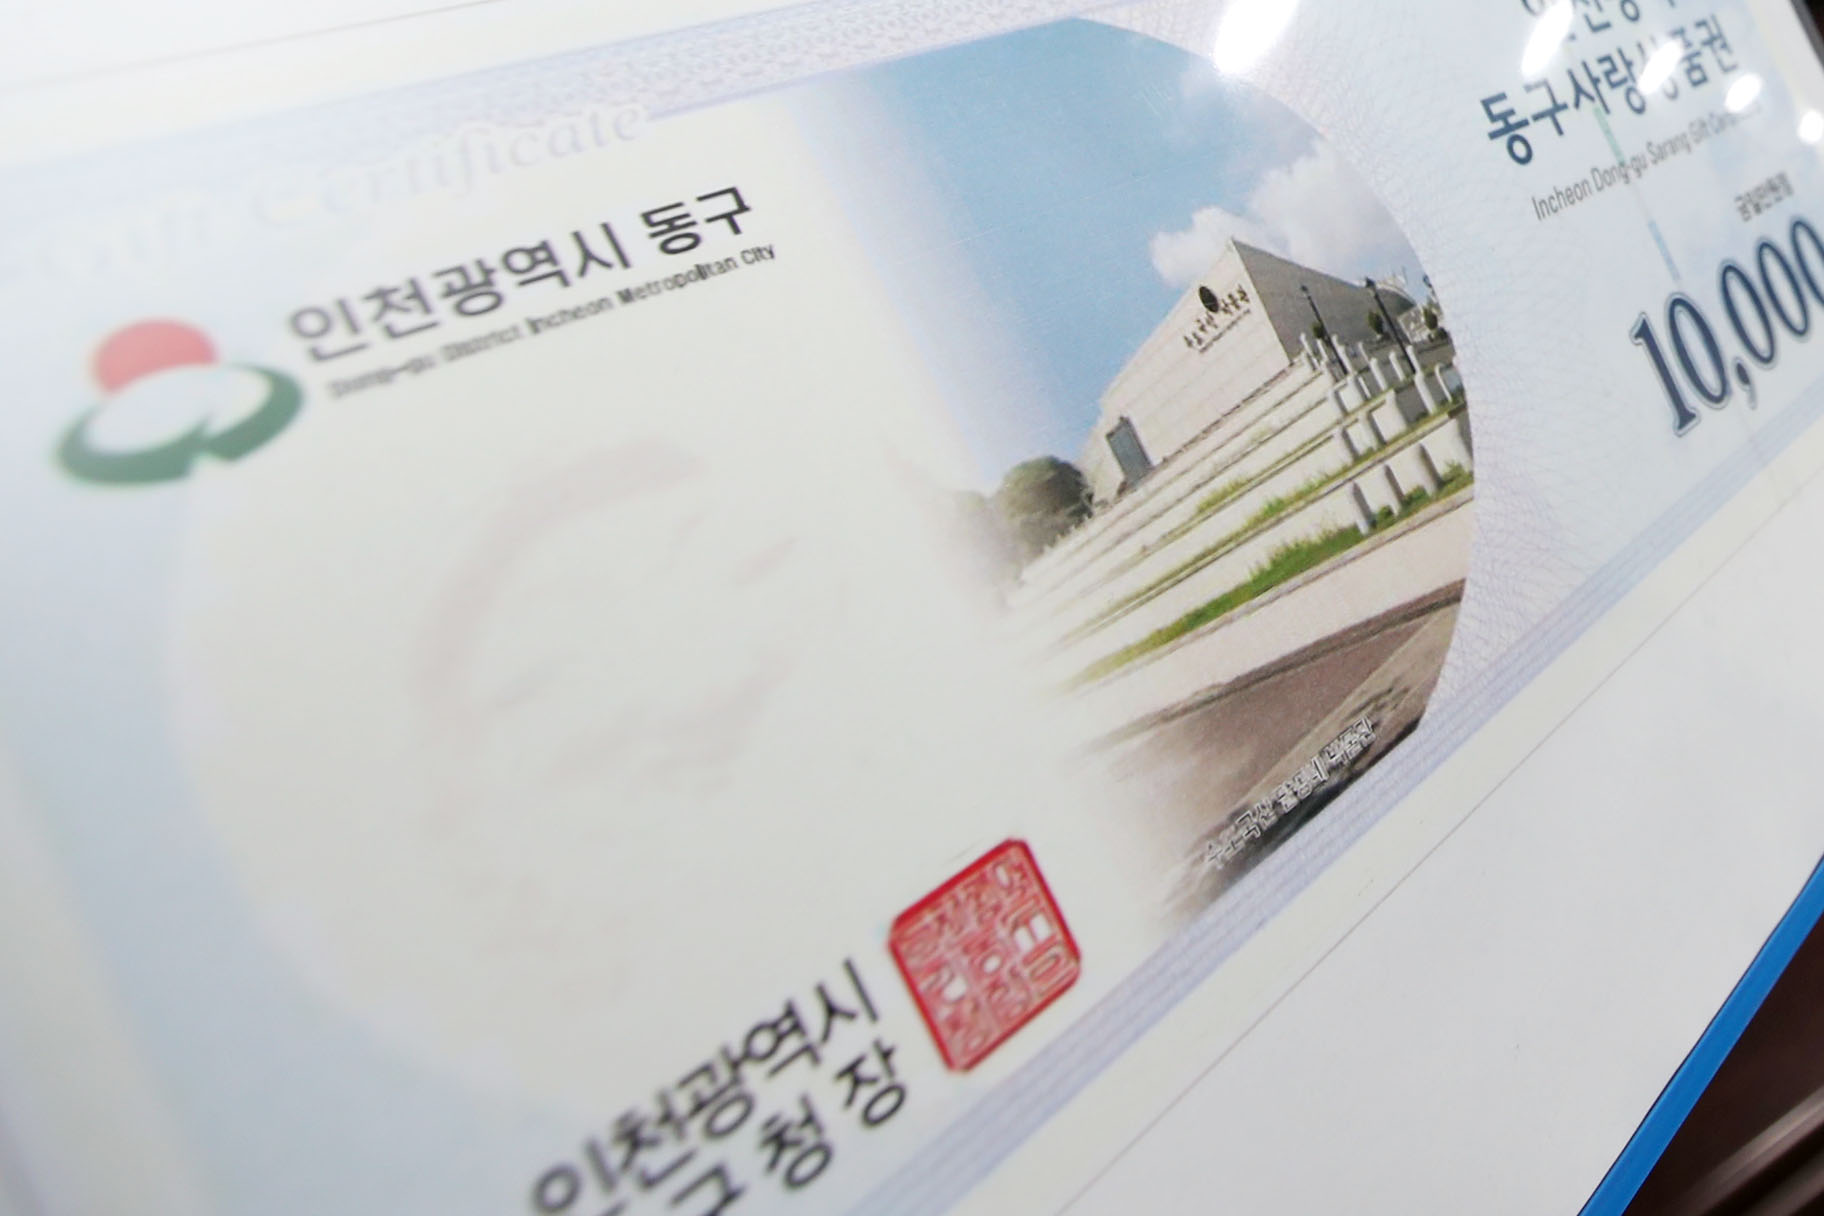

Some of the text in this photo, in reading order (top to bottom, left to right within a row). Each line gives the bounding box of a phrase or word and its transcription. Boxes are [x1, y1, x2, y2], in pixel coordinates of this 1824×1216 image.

[1480, 13, 1738, 166] 동구사랑품권
[1531, 180, 1593, 221] Incheon
[1590, 153, 1648, 192] Dong-gu
[1646, 131, 1692, 166] Sarang
[289, 186, 752, 363] 인천광역시 동구
[526, 294, 614, 335] Incheon
[616, 254, 738, 307] Metropolitan
[740, 241, 776, 267] City
[531, 957, 879, 1216] 인천광역시
